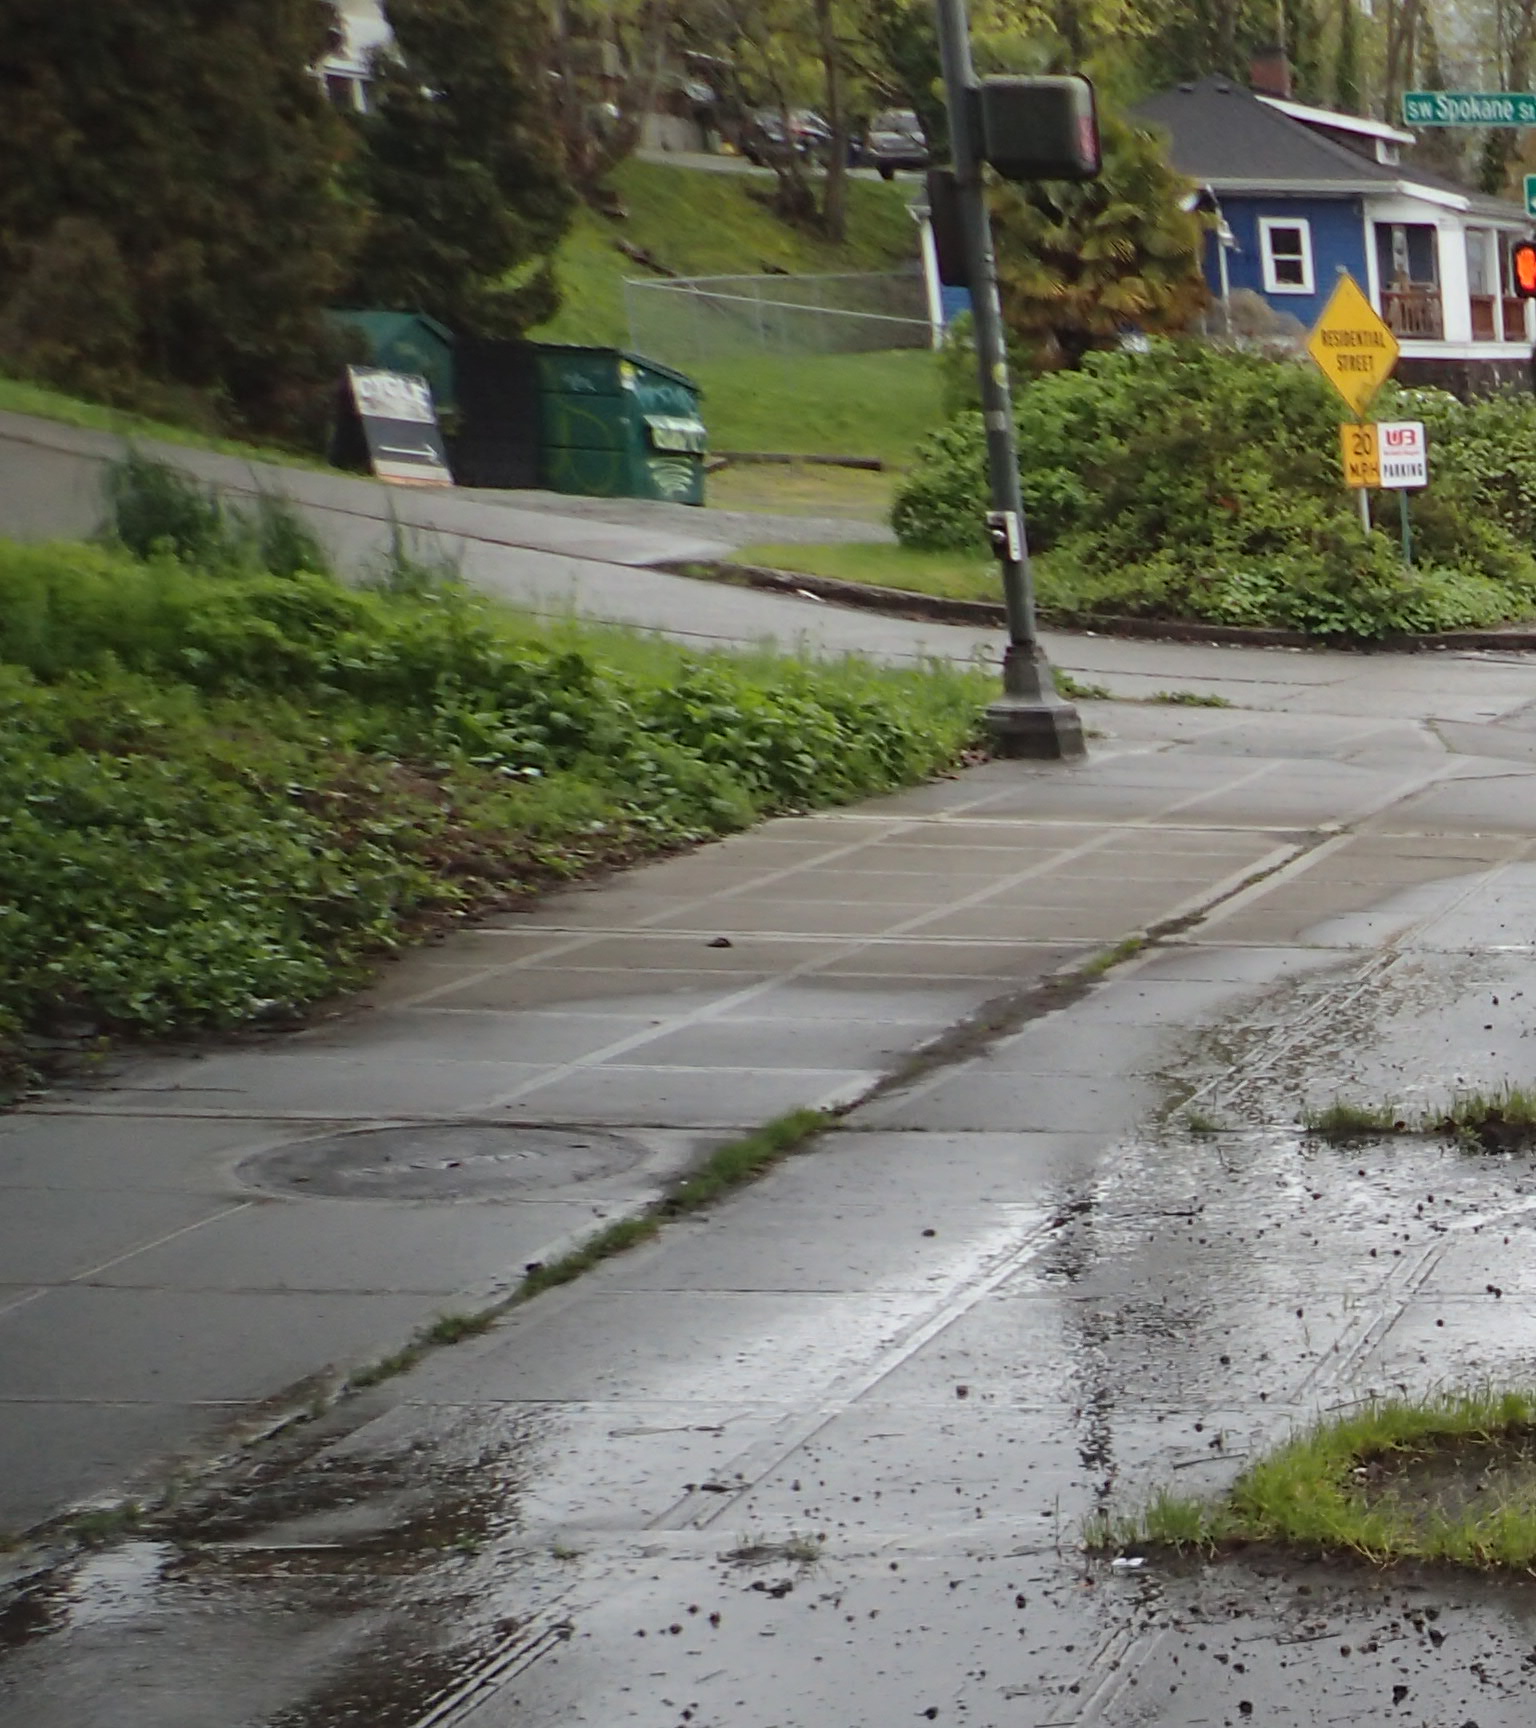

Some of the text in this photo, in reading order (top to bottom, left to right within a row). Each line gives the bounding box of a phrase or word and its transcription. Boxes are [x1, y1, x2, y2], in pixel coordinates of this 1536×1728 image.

[1407, 100, 1434, 120] SW
[1435, 94, 1515, 124] Spokane
[1519, 102, 1536, 121] St
[1321, 329, 1386, 348] RESIDENTIAL
[1336, 353, 1374, 372] STREET
[1352, 432, 1371, 456] 20
[1383, 462, 1423, 478] PARKING
